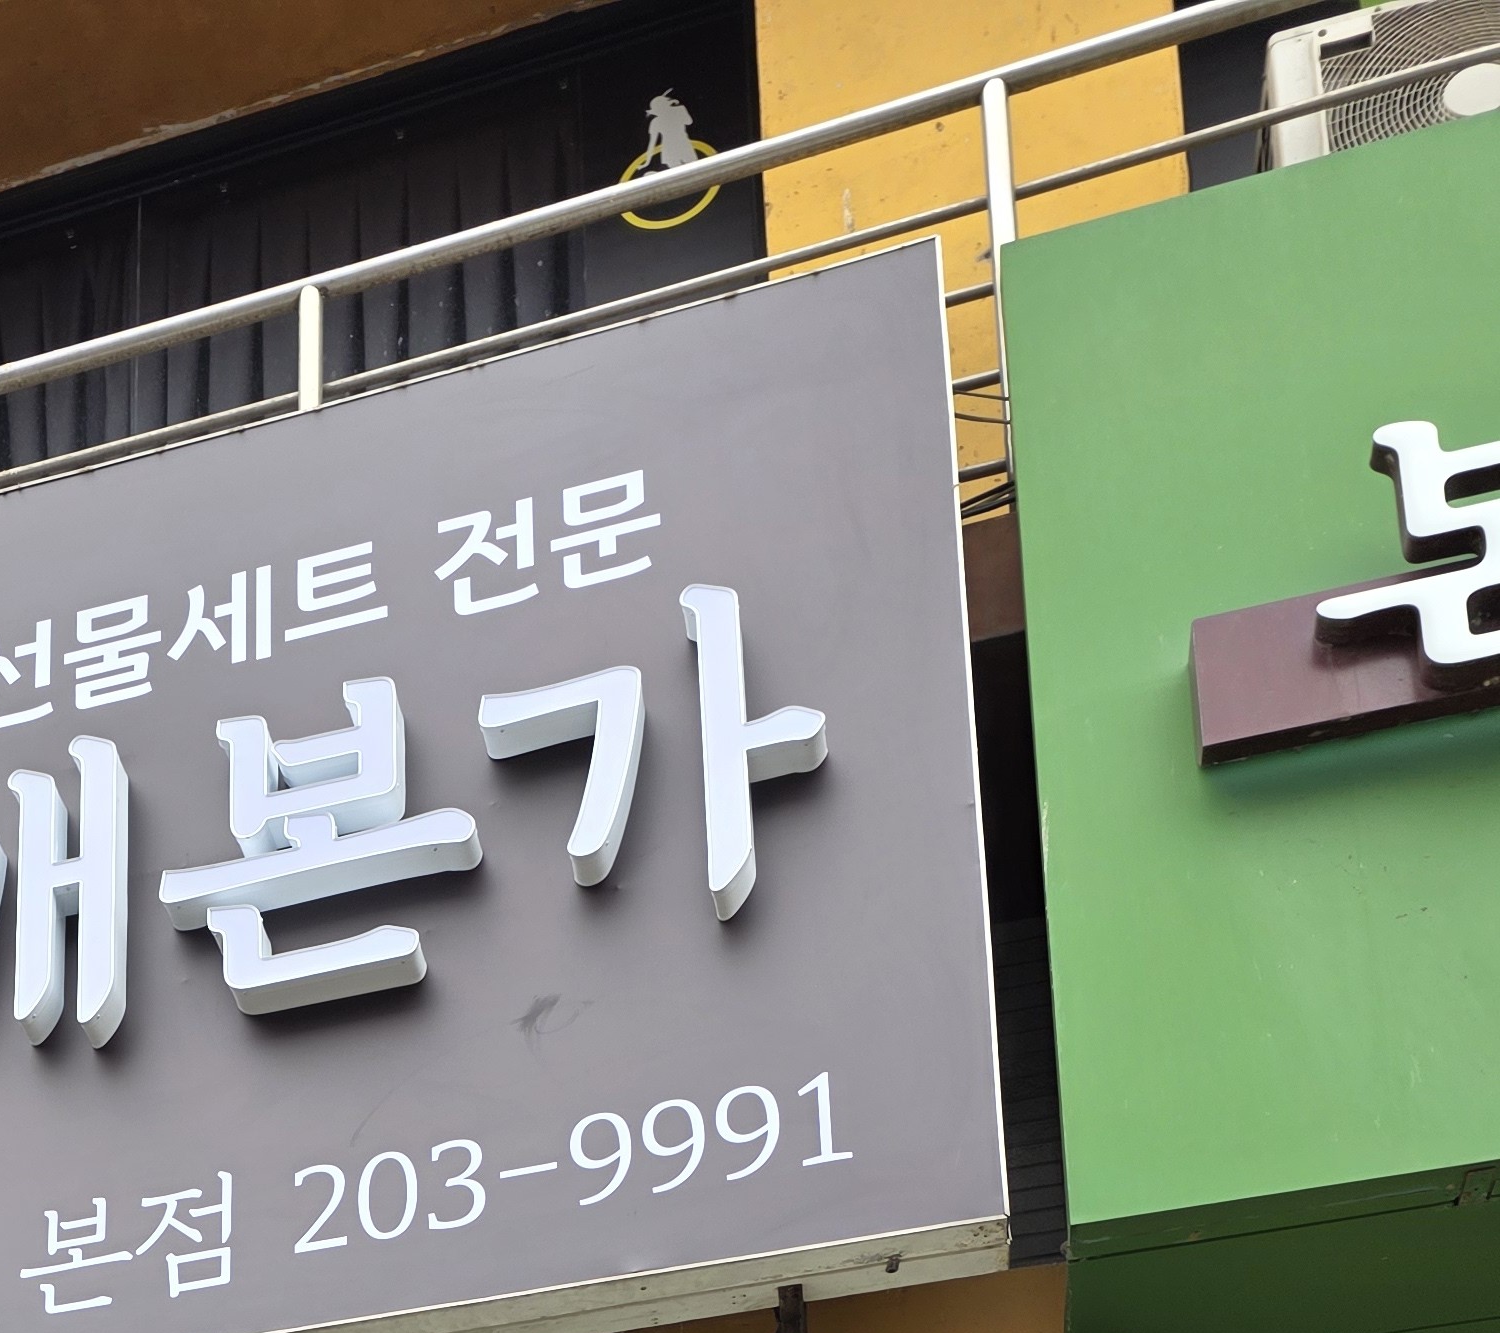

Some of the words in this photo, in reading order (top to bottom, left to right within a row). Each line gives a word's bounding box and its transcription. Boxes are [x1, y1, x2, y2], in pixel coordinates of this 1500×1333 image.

[434, 469, 662, 616] 전문
[19, 1170, 233, 1315] 본점
[292, 1070, 854, 1254] 203-9991
